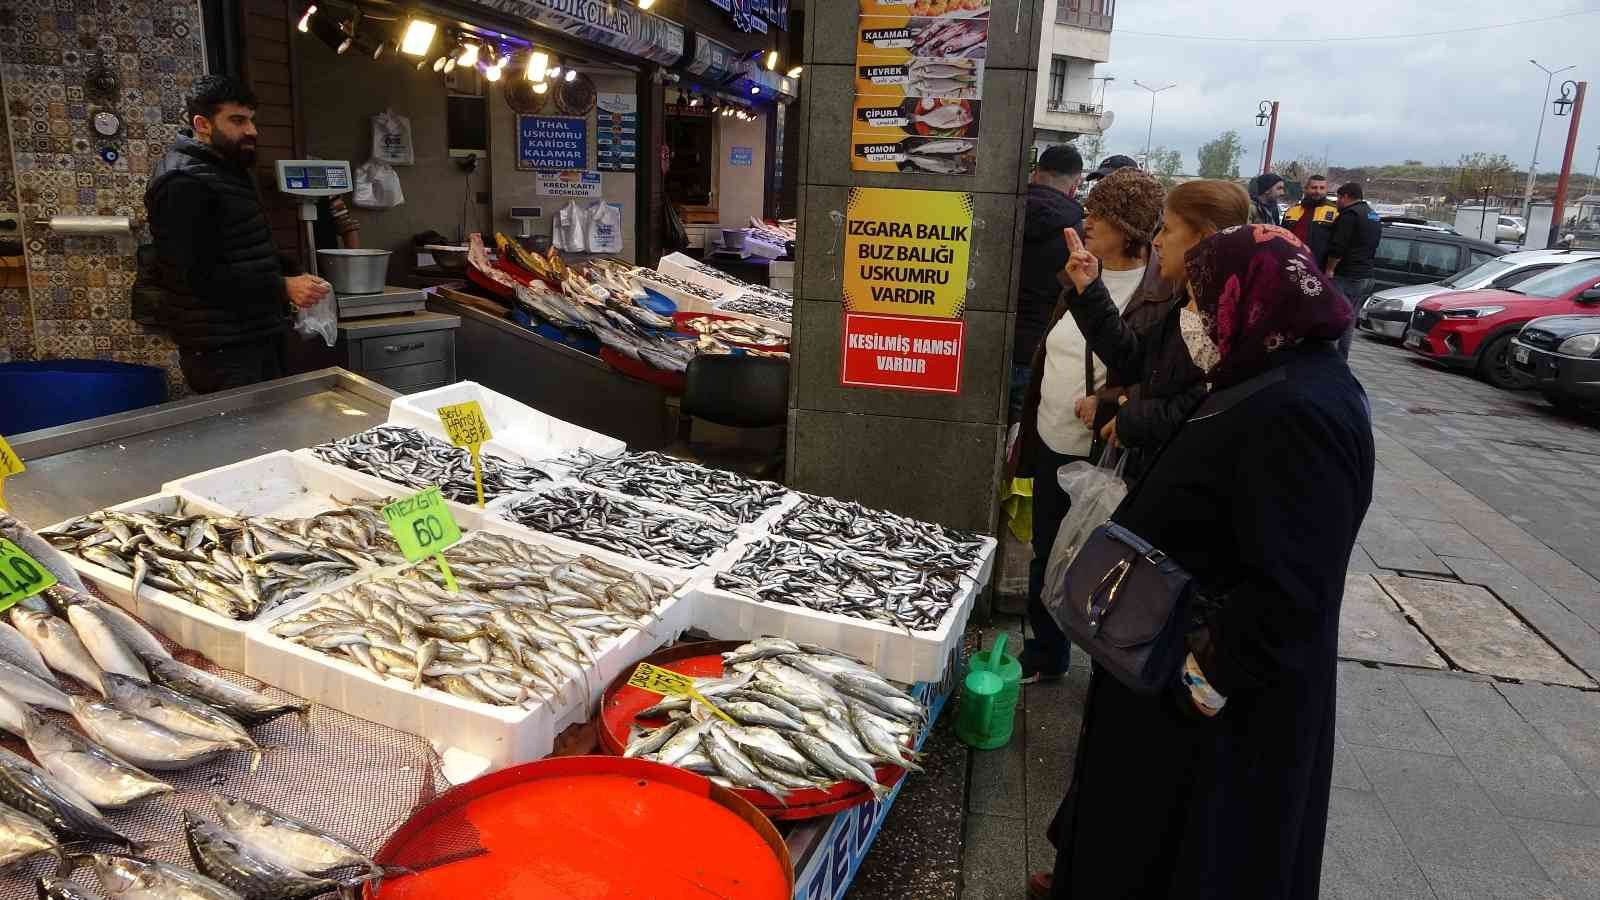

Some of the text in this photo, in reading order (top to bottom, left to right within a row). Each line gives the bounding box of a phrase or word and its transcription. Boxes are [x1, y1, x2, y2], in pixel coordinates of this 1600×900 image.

[865, 30, 909, 40] KALAMAR
[867, 67, 902, 77] LEVREK
[523, 130, 582, 140] USKUMRU
[524, 149, 582, 158] KALAMAR
[863, 145, 896, 154] SOMON
[531, 159, 576, 168] VARDIR
[848, 220, 968, 241] IZGARA BALIK
[858, 243, 954, 264] BUZ BALIĞI
[860, 265, 950, 285] USKUMRU
[871, 286, 936, 305] VARDIR
[848, 332, 958, 356] KESİLMİŞ HAMSİ
[876, 355, 926, 374] VARDIR
[412, 515, 444, 547] 60
